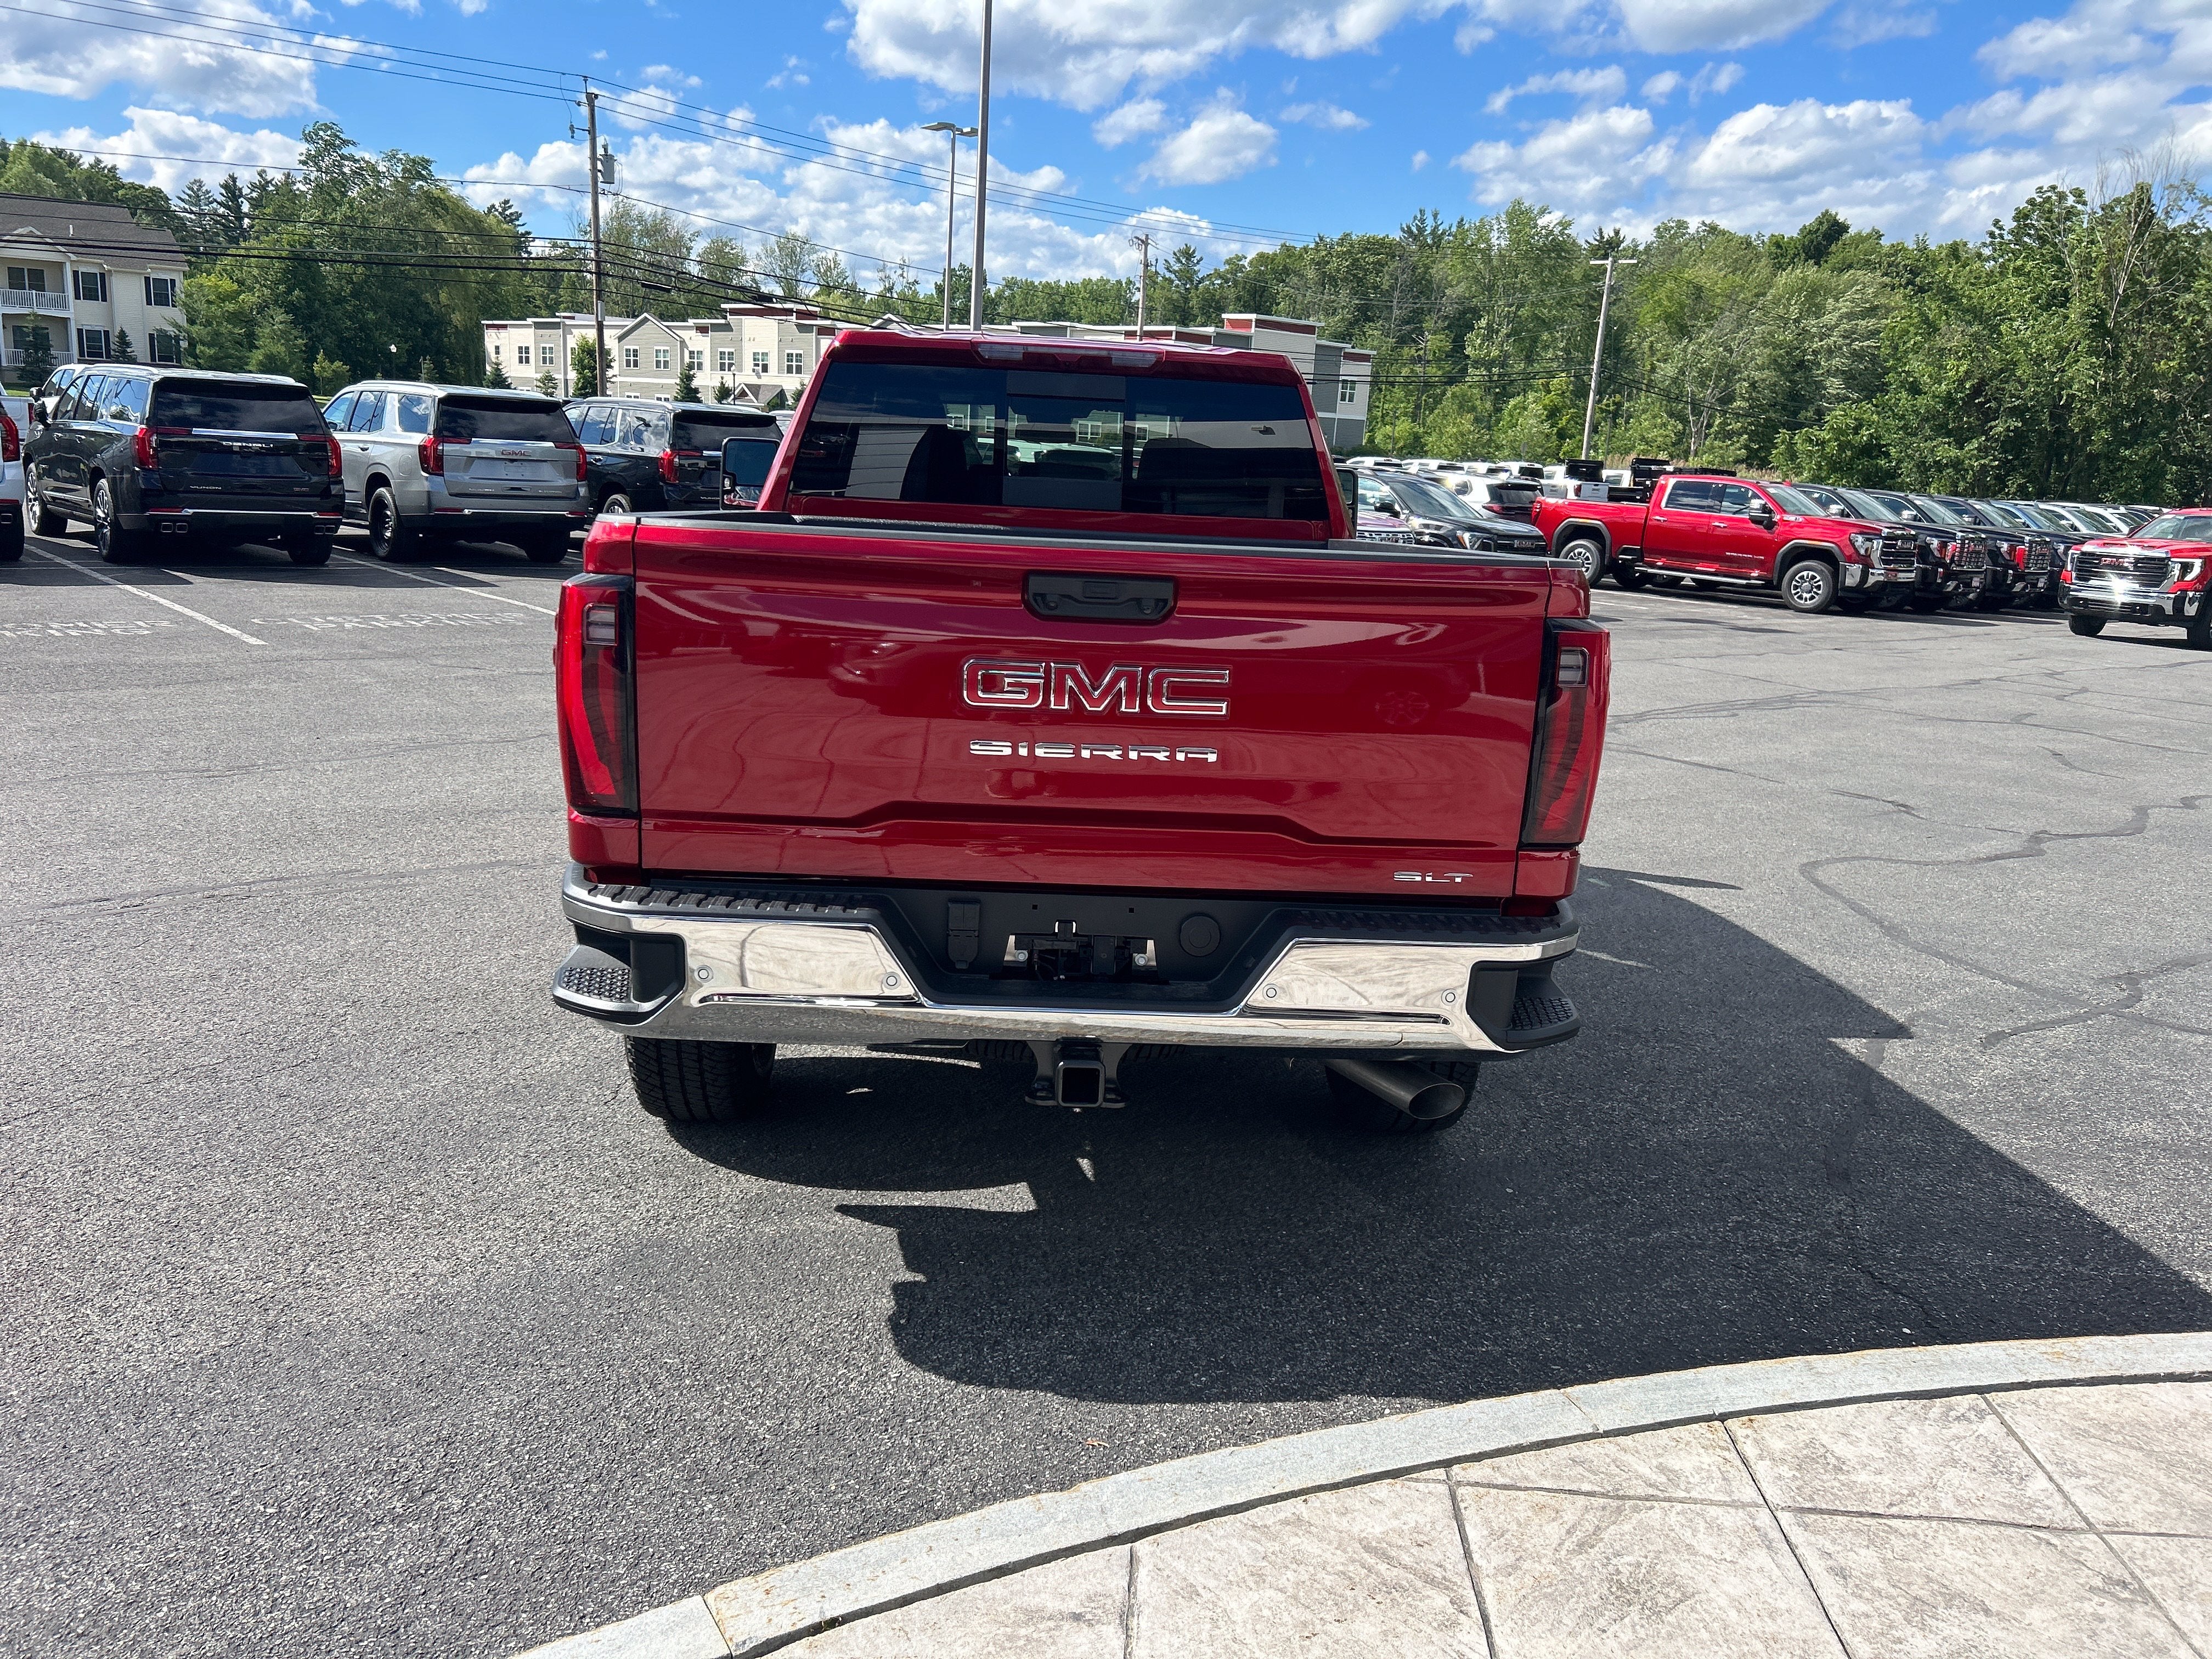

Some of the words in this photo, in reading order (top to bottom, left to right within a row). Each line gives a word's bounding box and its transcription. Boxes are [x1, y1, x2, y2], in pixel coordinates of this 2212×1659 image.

[963, 658, 1230, 715] GMC
[969, 740, 1218, 763] SIERRA
[1393, 871, 1474, 883] SLT
